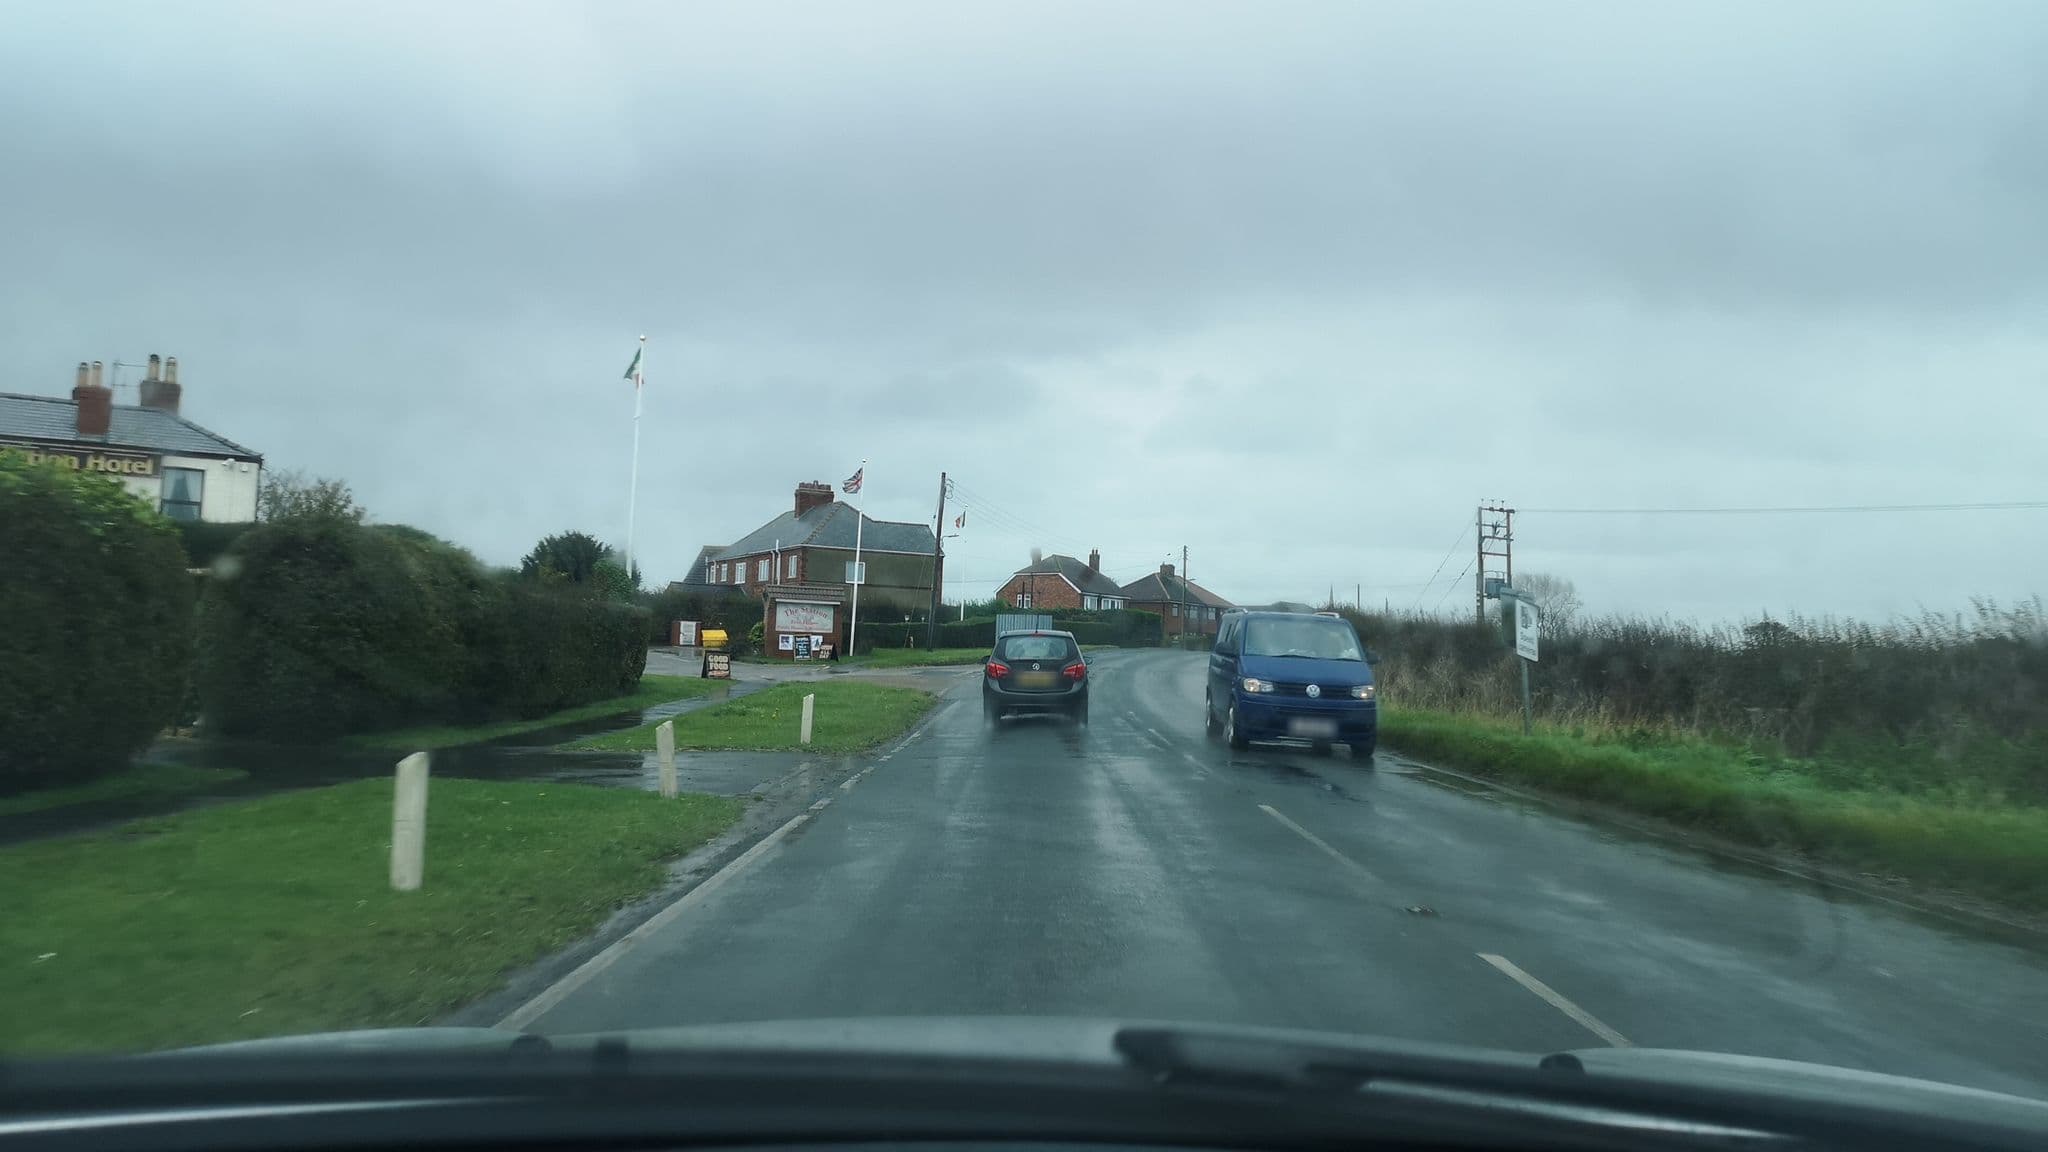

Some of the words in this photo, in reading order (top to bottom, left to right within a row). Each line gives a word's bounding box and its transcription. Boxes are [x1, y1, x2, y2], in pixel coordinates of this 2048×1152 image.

[86, 454, 153, 474] Hotel
[784, 607, 798, 617] The
[709, 662, 728, 670] FOOD
